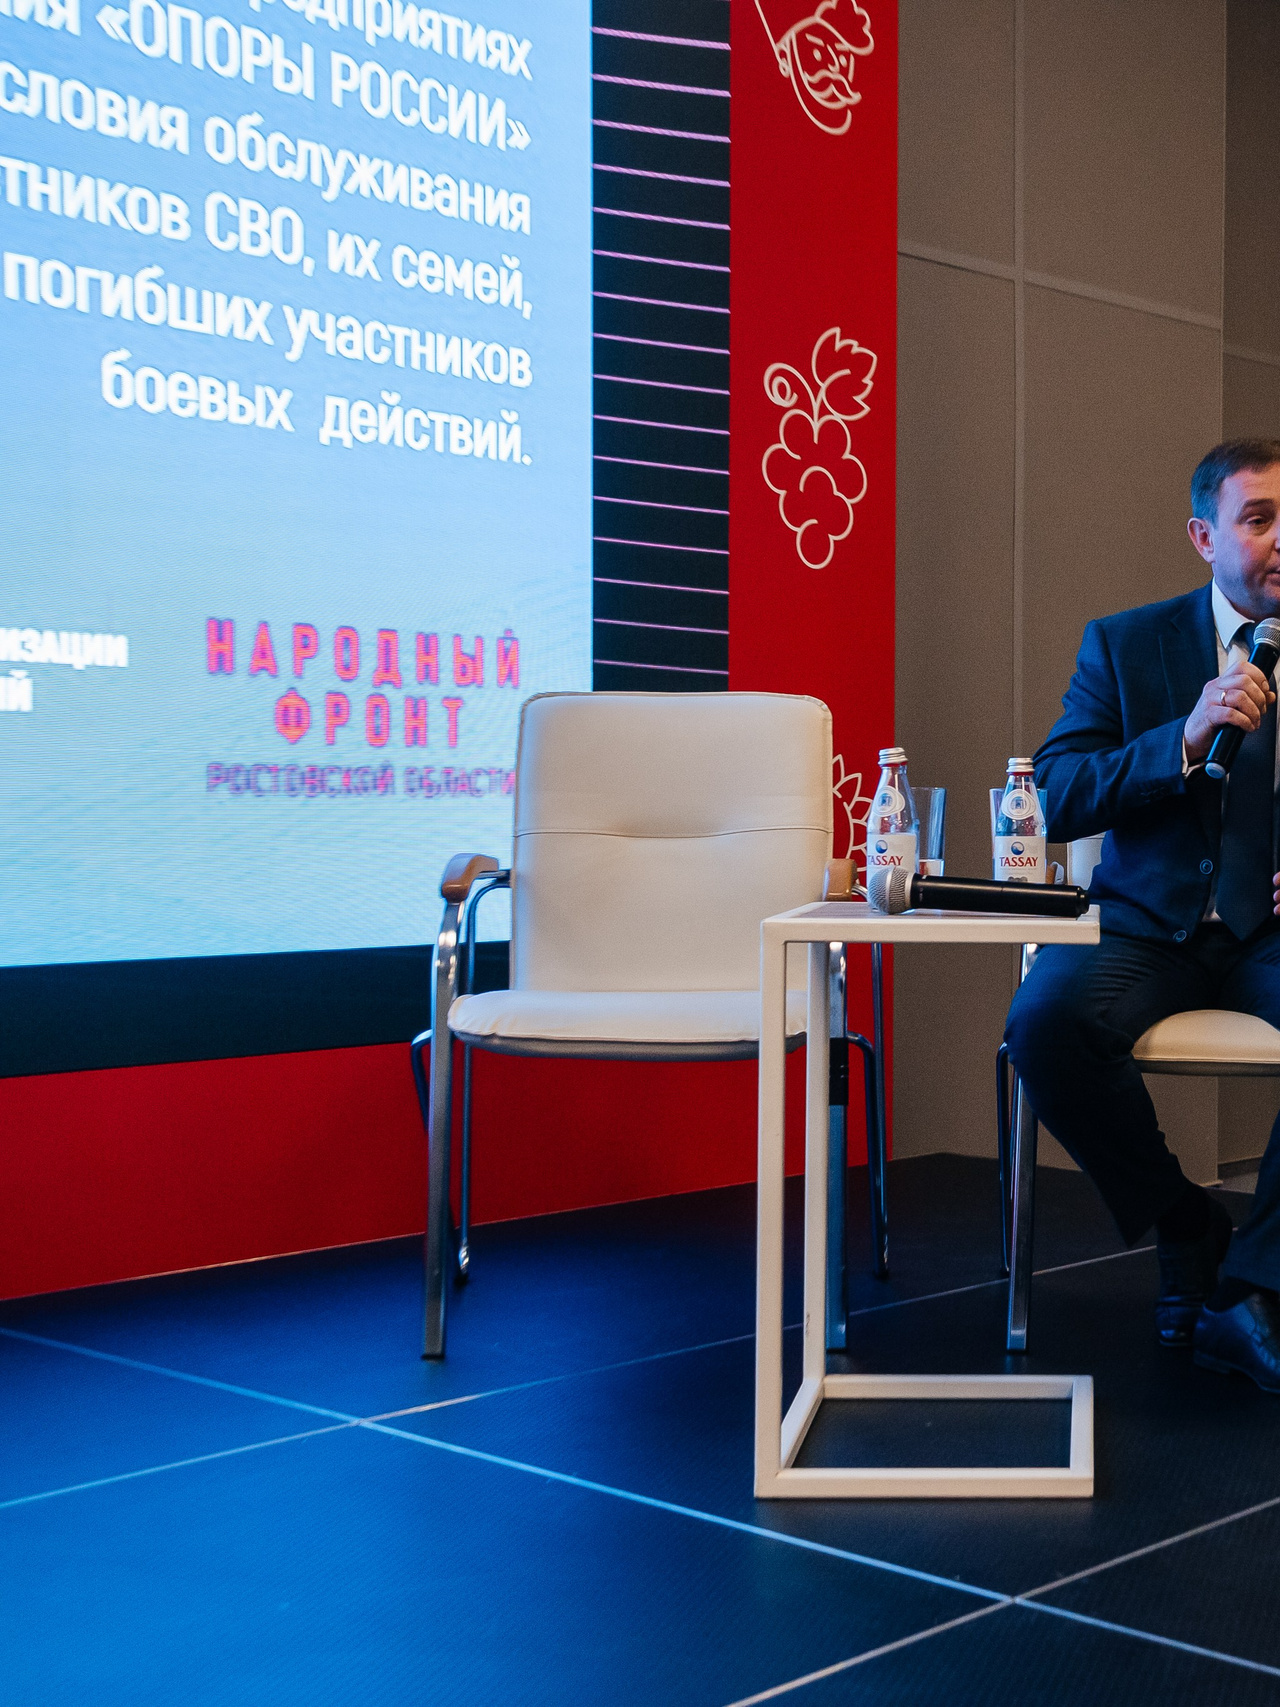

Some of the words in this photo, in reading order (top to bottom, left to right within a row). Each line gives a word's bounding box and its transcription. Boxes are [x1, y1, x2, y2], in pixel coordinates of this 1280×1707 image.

[95, 0, 316, 100] «ОПОРЫ
[330, 50, 533, 152] РОССИИ»
[248, 0, 533, 81] дприятиях
[0, 60, 190, 155] словия
[204, 112, 532, 235] обслуживания
[0, 156, 191, 242] тников
[204, 191, 315, 276] СВО,
[327, 228, 381, 281] их
[391, 244, 533, 320] семей,
[3, 251, 274, 346] погибших
[283, 304, 534, 388] участников
[101, 348, 295, 432] боевых
[319, 390, 533, 466] действий.
[206, 617, 520, 688] НАРОДНЫЙ
[274, 686, 464, 747] ФРОНТ
[206, 760, 395, 798] РОСТОВСКОЙ
[403, 765, 516, 798] ОБЛАСТИ
[867, 855, 904, 866] TASSAY
[999, 856, 1038, 867] TASSAY
